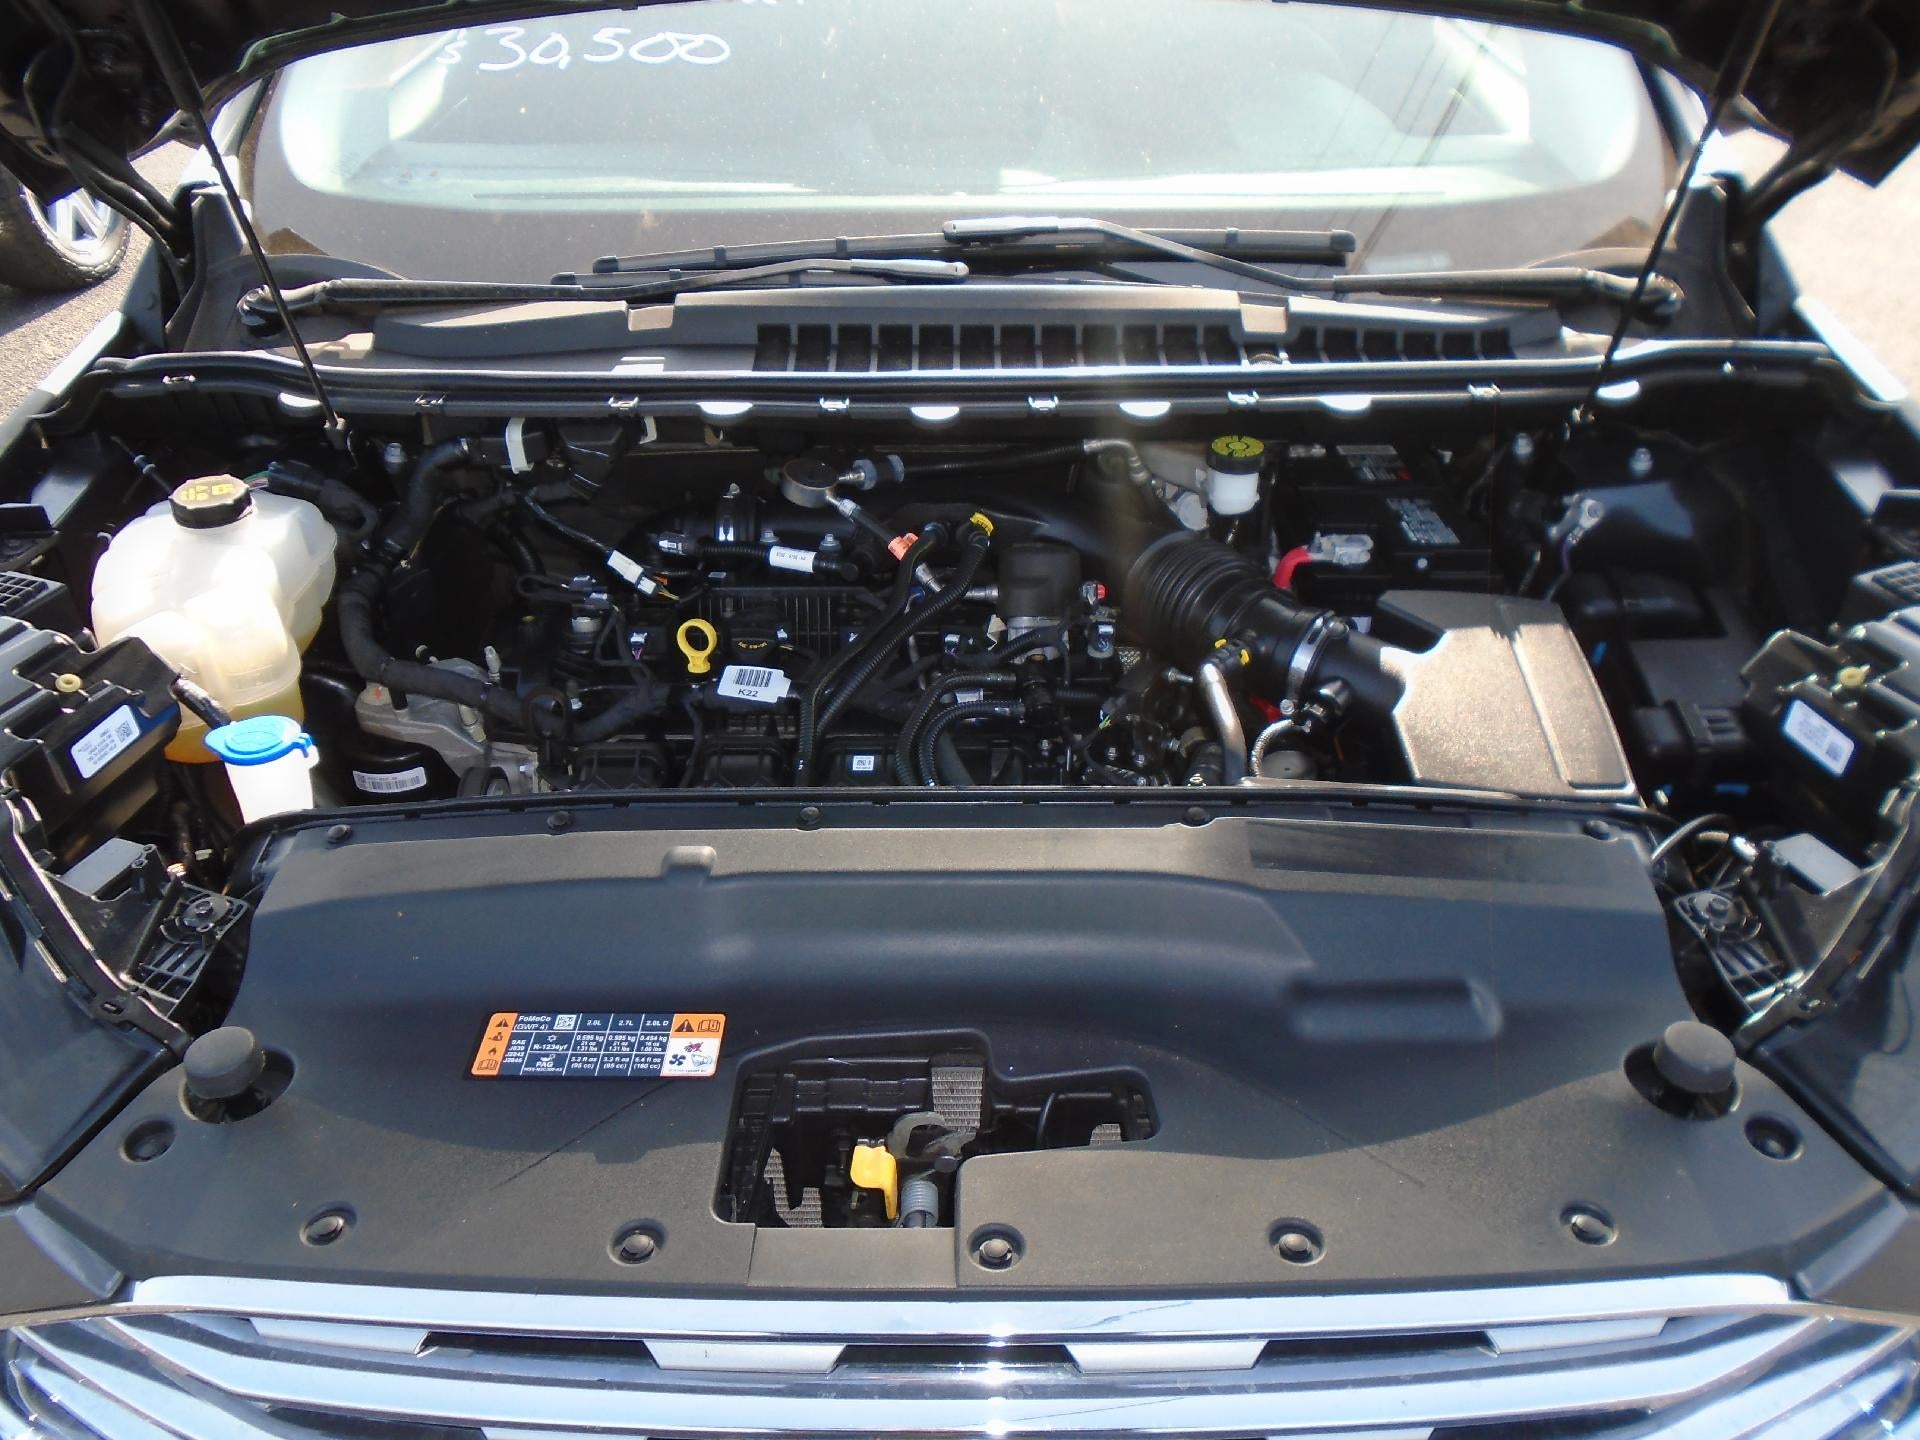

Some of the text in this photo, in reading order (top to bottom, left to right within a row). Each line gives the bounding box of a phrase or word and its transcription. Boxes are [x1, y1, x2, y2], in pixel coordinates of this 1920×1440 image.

[738, 688, 759, 698] K22
[627, 1035, 636, 1043] kg
[659, 1035, 668, 1043] kg
[532, 1043, 568, 1052] R-1234yf
